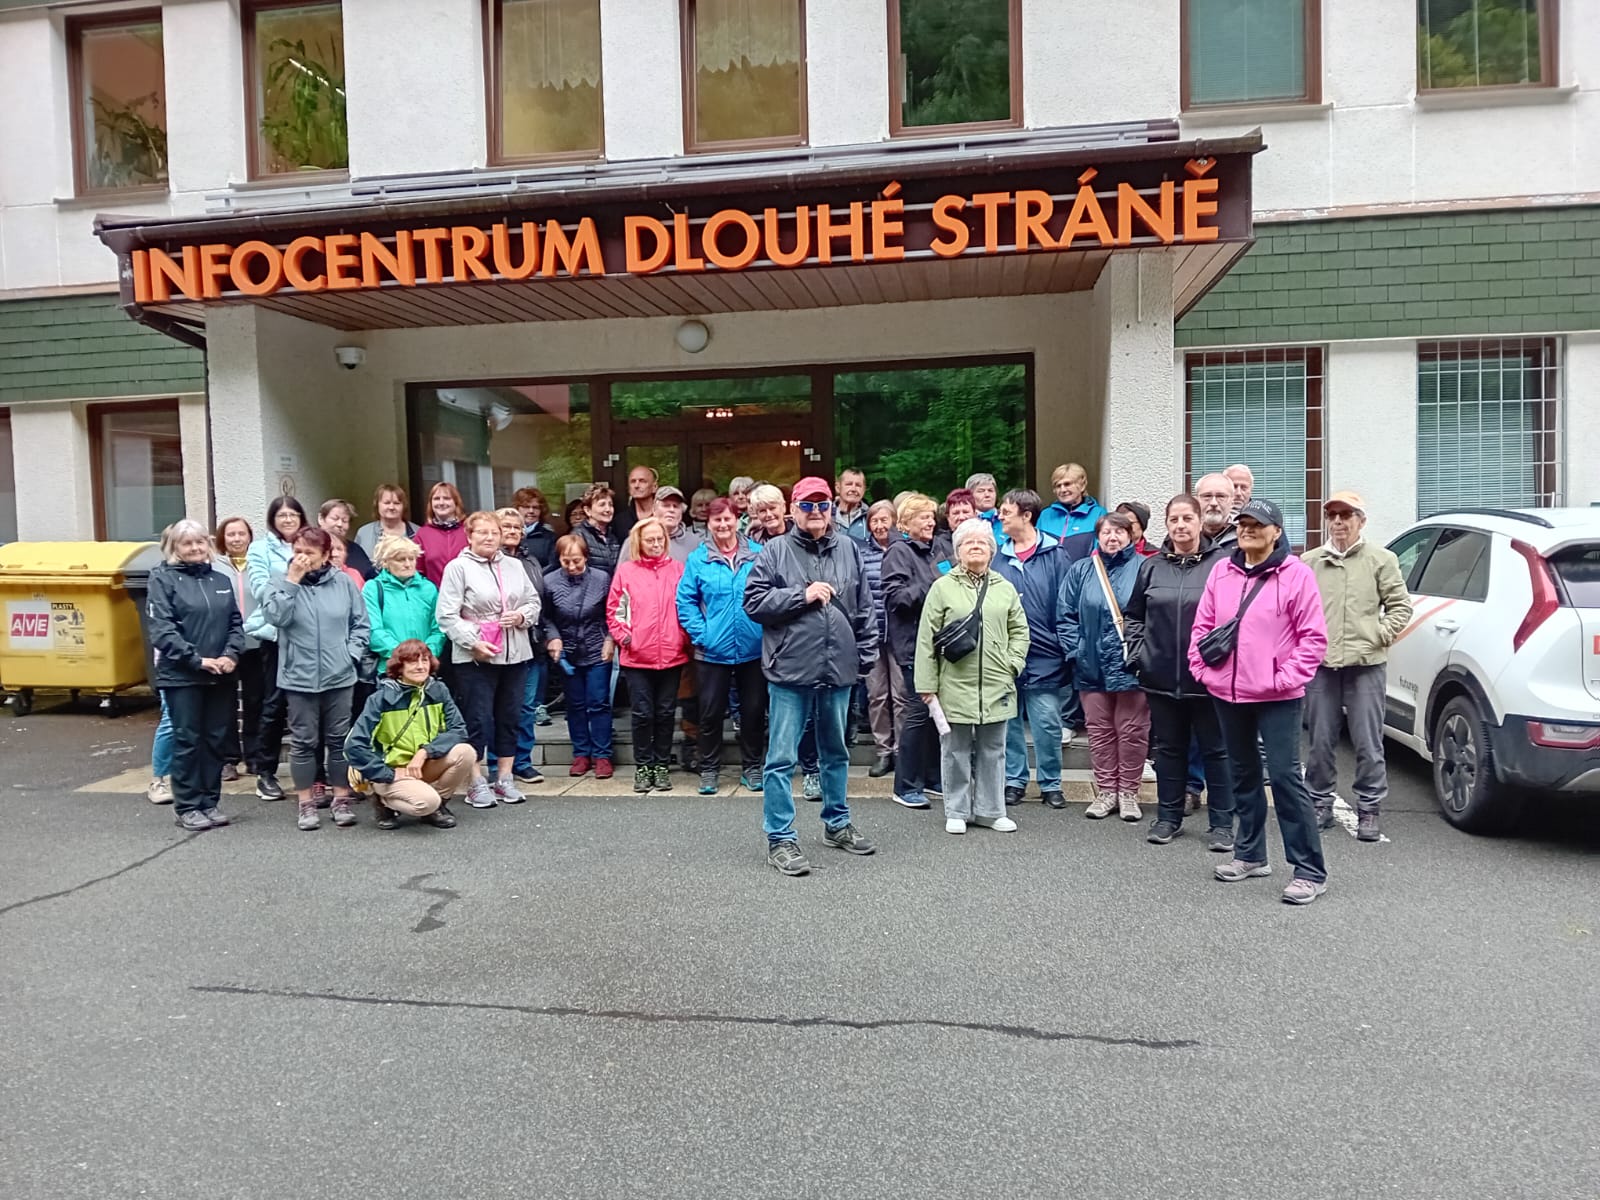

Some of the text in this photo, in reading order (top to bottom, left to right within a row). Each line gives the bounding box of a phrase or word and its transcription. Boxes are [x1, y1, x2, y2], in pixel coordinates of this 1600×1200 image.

[132, 158, 1219, 302] INFOCENTRUM DLOUHÉ STRÁNĚ
[11, 617, 48, 633] AVE
